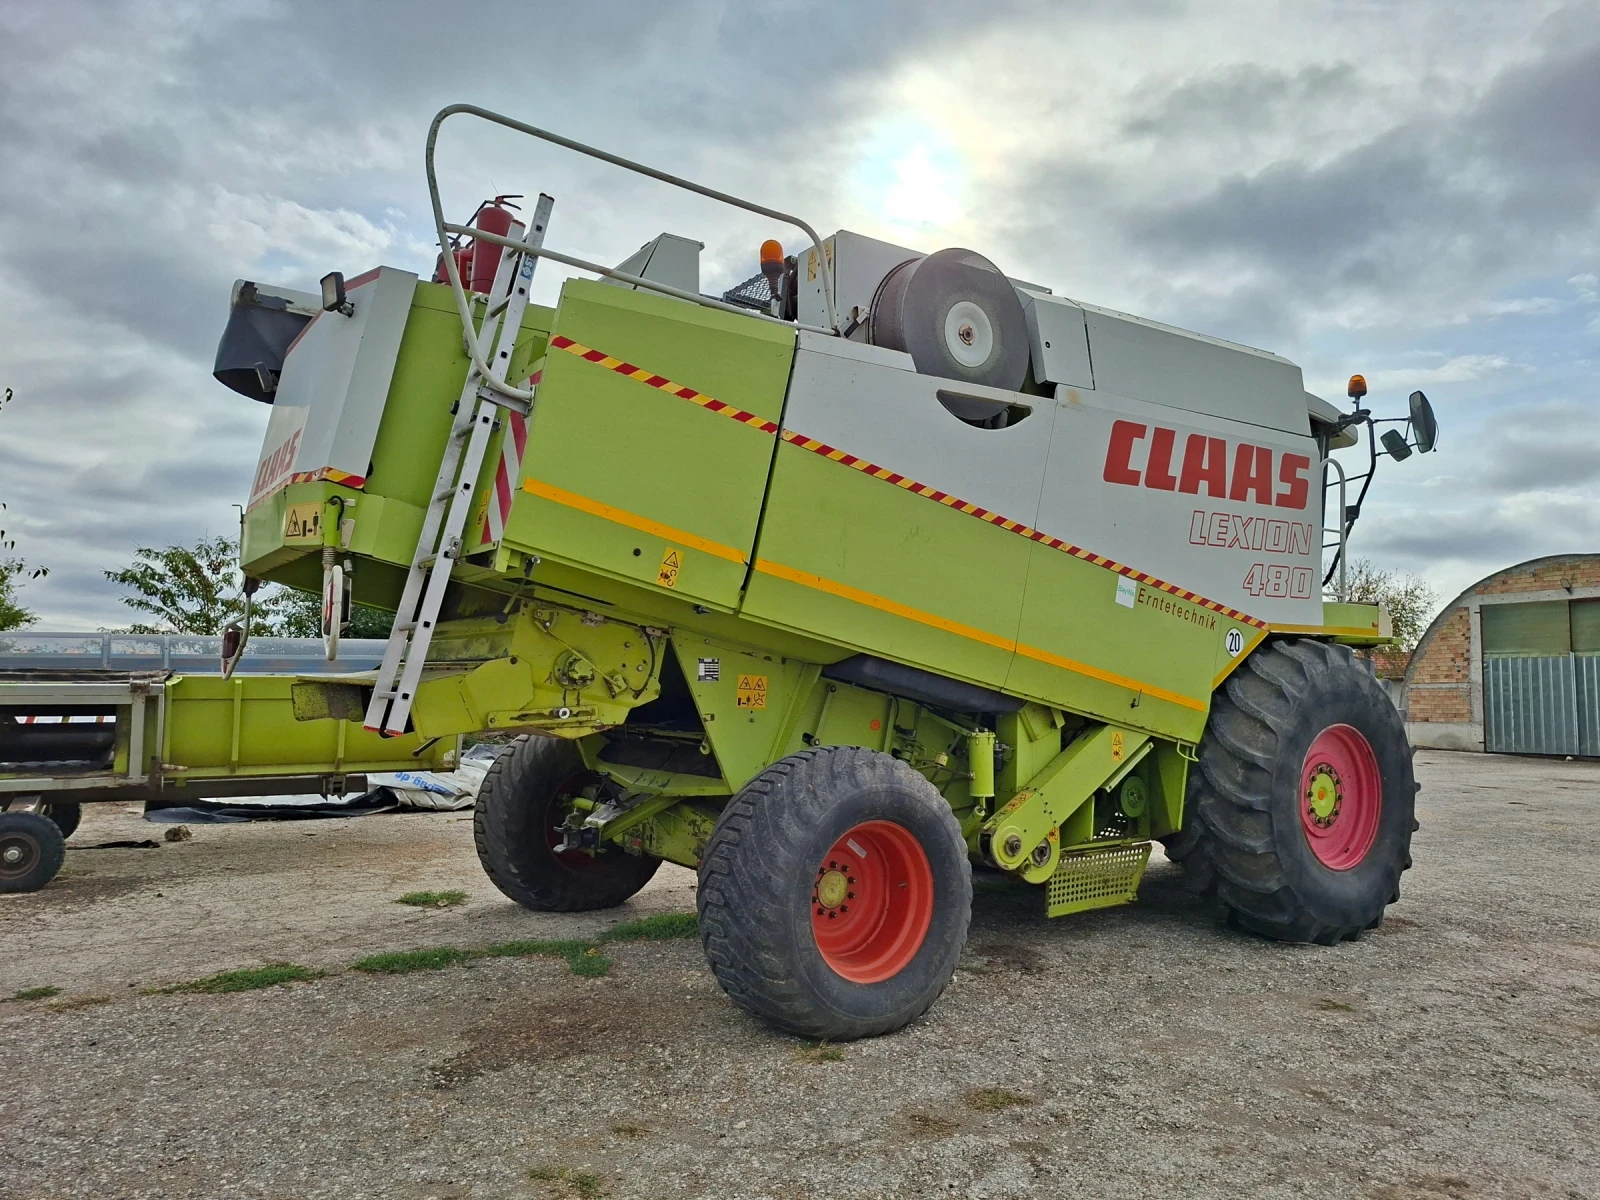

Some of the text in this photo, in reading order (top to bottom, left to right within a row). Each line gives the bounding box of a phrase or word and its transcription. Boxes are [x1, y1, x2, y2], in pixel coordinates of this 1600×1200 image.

[253, 428, 302, 497] CLAAS
[1102, 419, 1311, 511] CLAAS
[1188, 510, 1313, 555] LEXION
[1243, 563, 1313, 599] 480
[1137, 588, 1216, 631] Erntetechnik
[1228, 632, 1243, 652] 20
